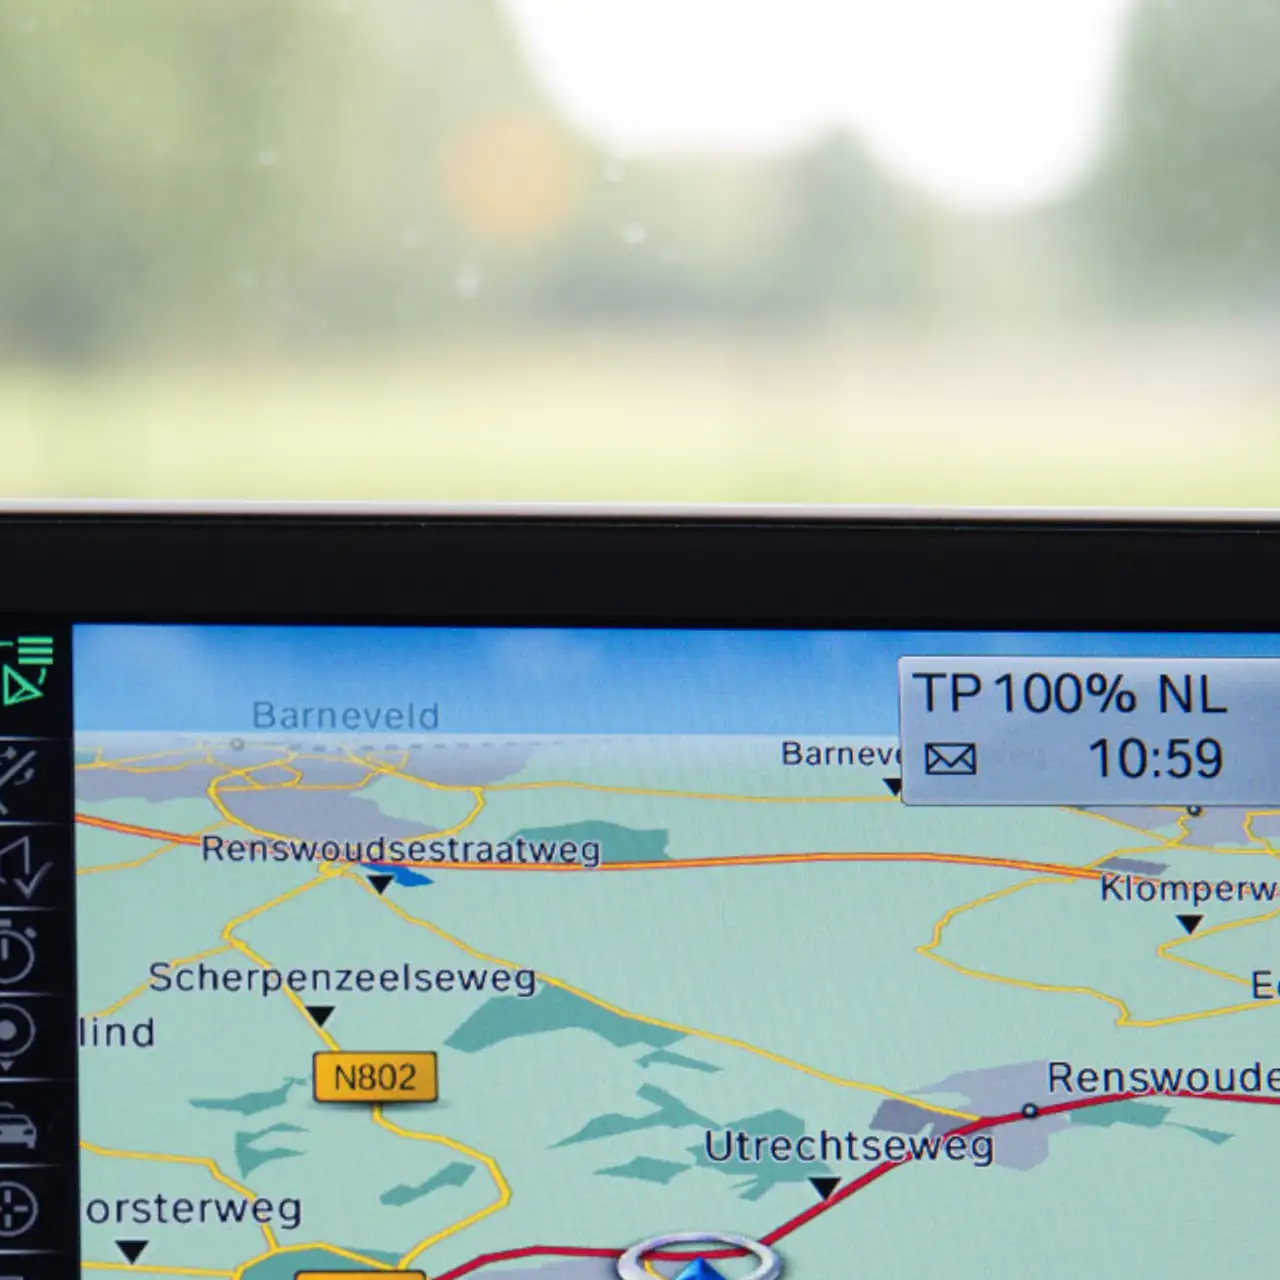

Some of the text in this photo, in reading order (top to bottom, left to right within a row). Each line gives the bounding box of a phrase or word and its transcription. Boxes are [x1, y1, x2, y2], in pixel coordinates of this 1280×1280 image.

[912, 672, 1228, 714] TP 100% NL
[252, 702, 439, 730] Barneveld
[782, 741, 901, 765] Barnev
[1089, 737, 1223, 779] 10:59
[201, 836, 601, 867] Renswoudsestraatweg
[148, 963, 537, 996] Scherpenzeelseweg
[79, 1016, 154, 1048] lind
[334, 1064, 417, 1091] N802
[705, 1130, 995, 1166] Utrechtseweg
[86, 1194, 302, 1228] orsterweg
